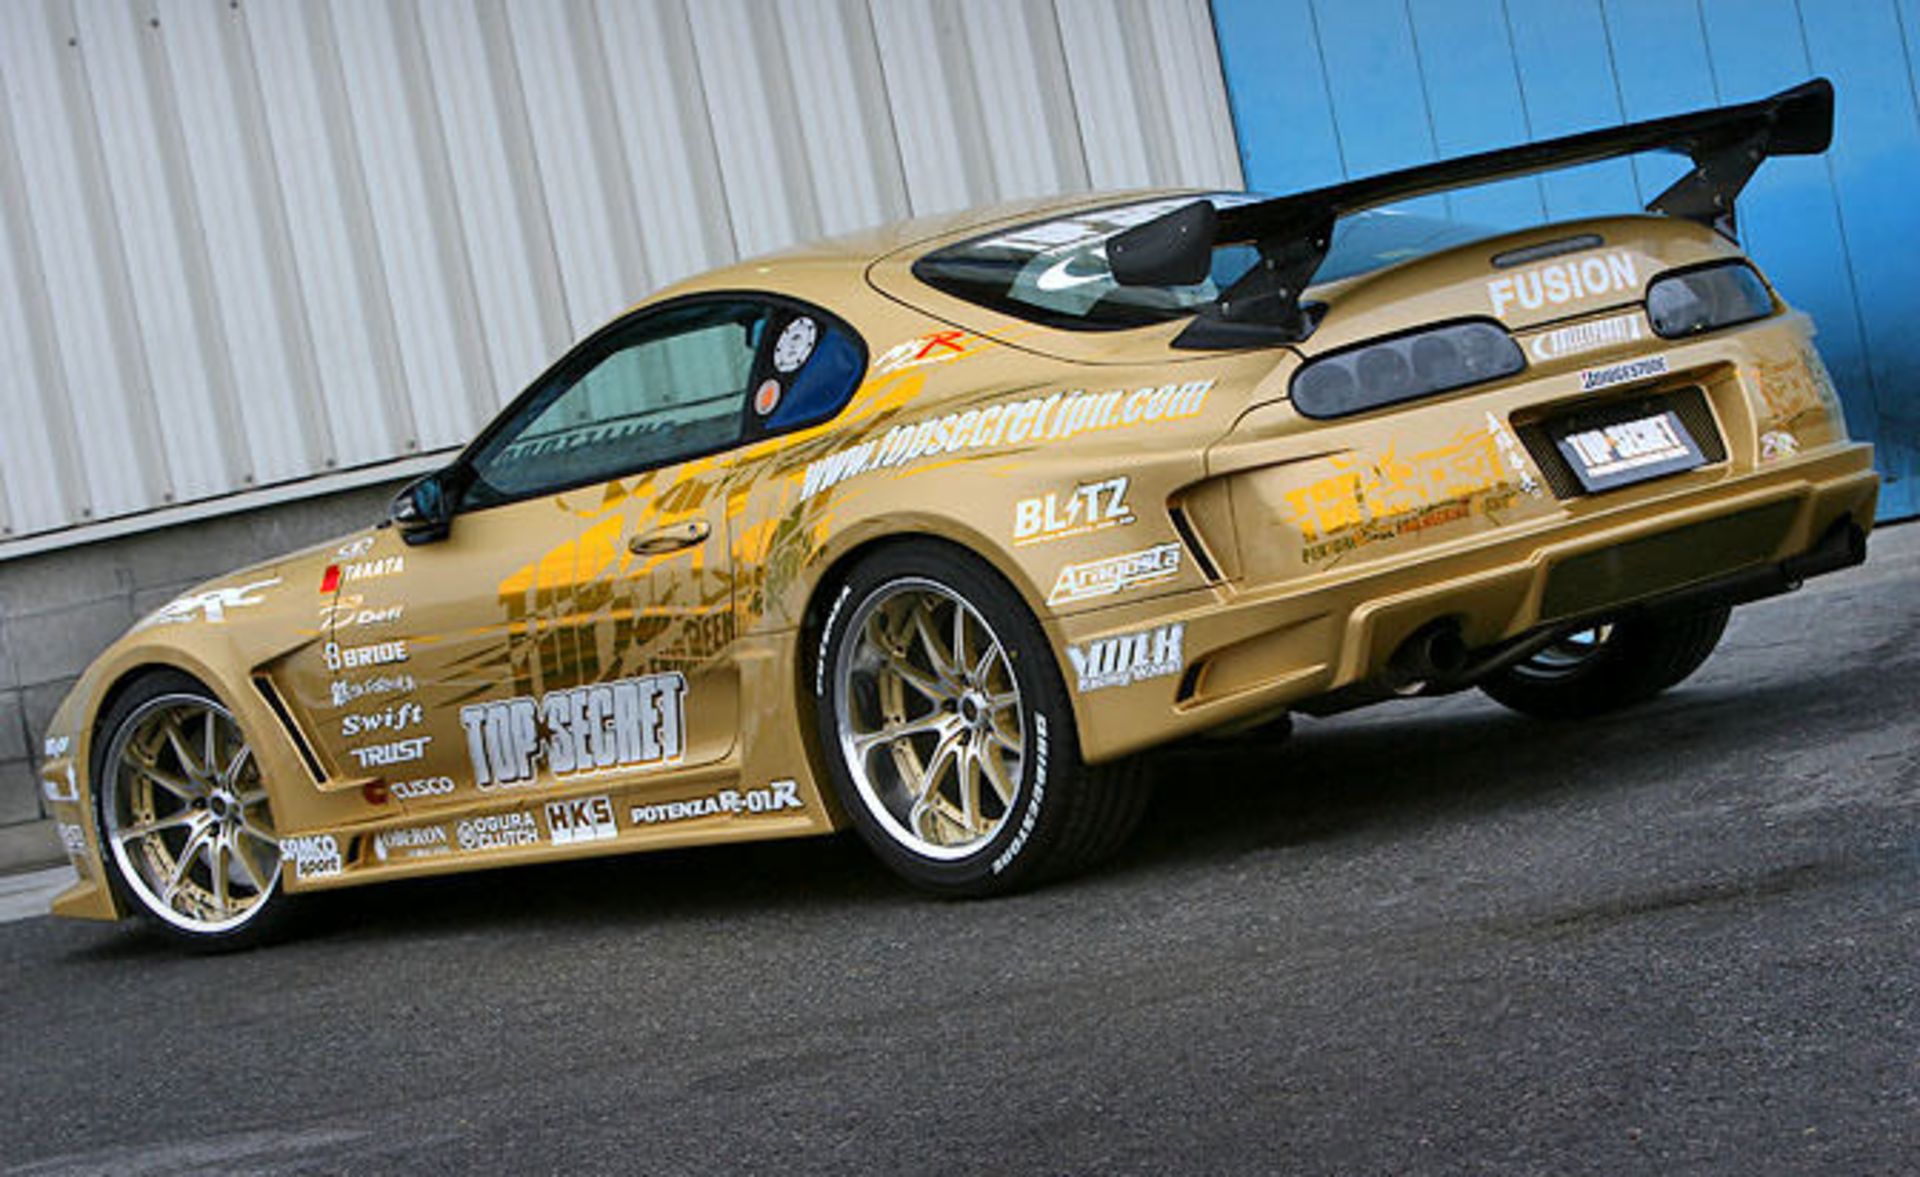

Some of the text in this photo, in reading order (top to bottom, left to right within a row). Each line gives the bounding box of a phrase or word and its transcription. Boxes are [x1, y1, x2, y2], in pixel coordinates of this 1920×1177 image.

[1487, 253, 1638, 318] FUSION
[1013, 476, 1131, 540] BLITZ
[343, 556, 404, 582] TAKATA
[342, 640, 409, 669] BRIDE
[341, 702, 424, 737] Swift
[460, 671, 688, 791] TOP SECRET
[350, 732, 433, 769] TRUST
[389, 775, 456, 801] CUSCO
[473, 811, 536, 834] OGURA
[548, 799, 612, 832] HKS
[631, 796, 720, 824] POTENZA
[299, 854, 339, 878] sport
